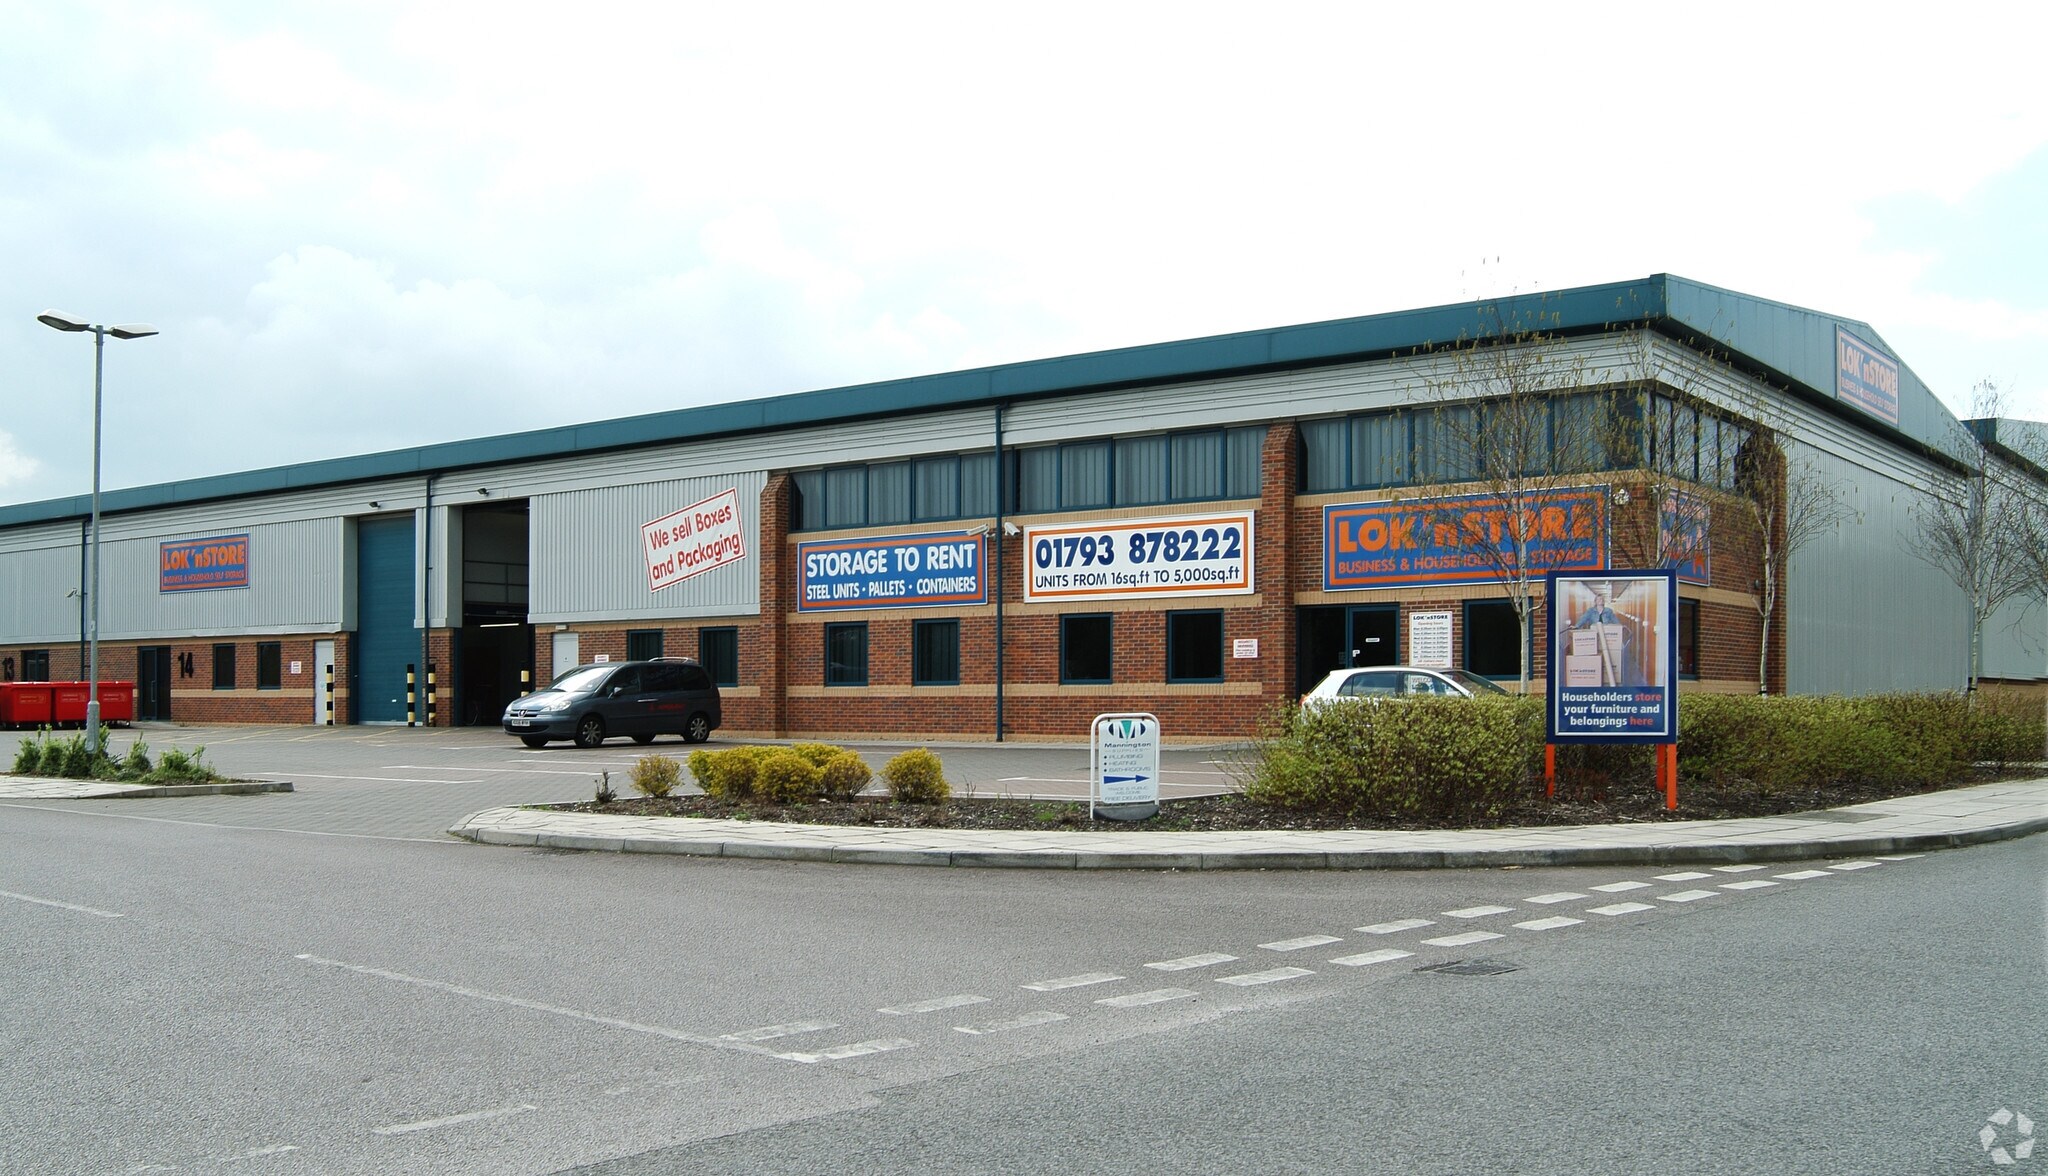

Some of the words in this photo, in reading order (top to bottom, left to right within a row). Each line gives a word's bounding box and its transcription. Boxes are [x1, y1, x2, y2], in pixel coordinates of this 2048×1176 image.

[649, 529, 669, 550] We
[672, 516, 692, 542] sell
[695, 505, 732, 532] Boxes
[652, 554, 674, 580] and
[677, 533, 741, 571] Packaging
[806, 549, 888, 578] STORAGE
[894, 547, 920, 572] TO
[926, 543, 976, 571] RENT
[1035, 535, 1115, 569] 01793
[1128, 527, 1241, 564] 878222
[1338, 559, 1396, 574] BUSINESS
[1400, 558, 1410, 571] &
[1530, 547, 1593, 563] STORAGE
[806, 584, 830, 600] STEEL
[832, 582, 860, 599] UNITS
[868, 580, 905, 597] PALLETS
[916, 576, 976, 595] CONTAINERS
[1035, 574, 1069, 588] UNITS
[1073, 572, 1107, 587] FROM
[1111, 570, 1150, 587] 16sq.ft
[1153, 570, 1170, 583] TO
[1173, 566, 1240, 584] 5,000sq.ft
[178, 652, 194, 678] 14
[1562, 692, 1633, 702] Householders
[1635, 693, 1662, 702] store
[1564, 706, 1588, 716] your
[1591, 704, 1638, 714] furniture
[1640, 704, 1660, 714] and
[1570, 716, 1628, 728] belongings
[1629, 716, 1654, 726] here
